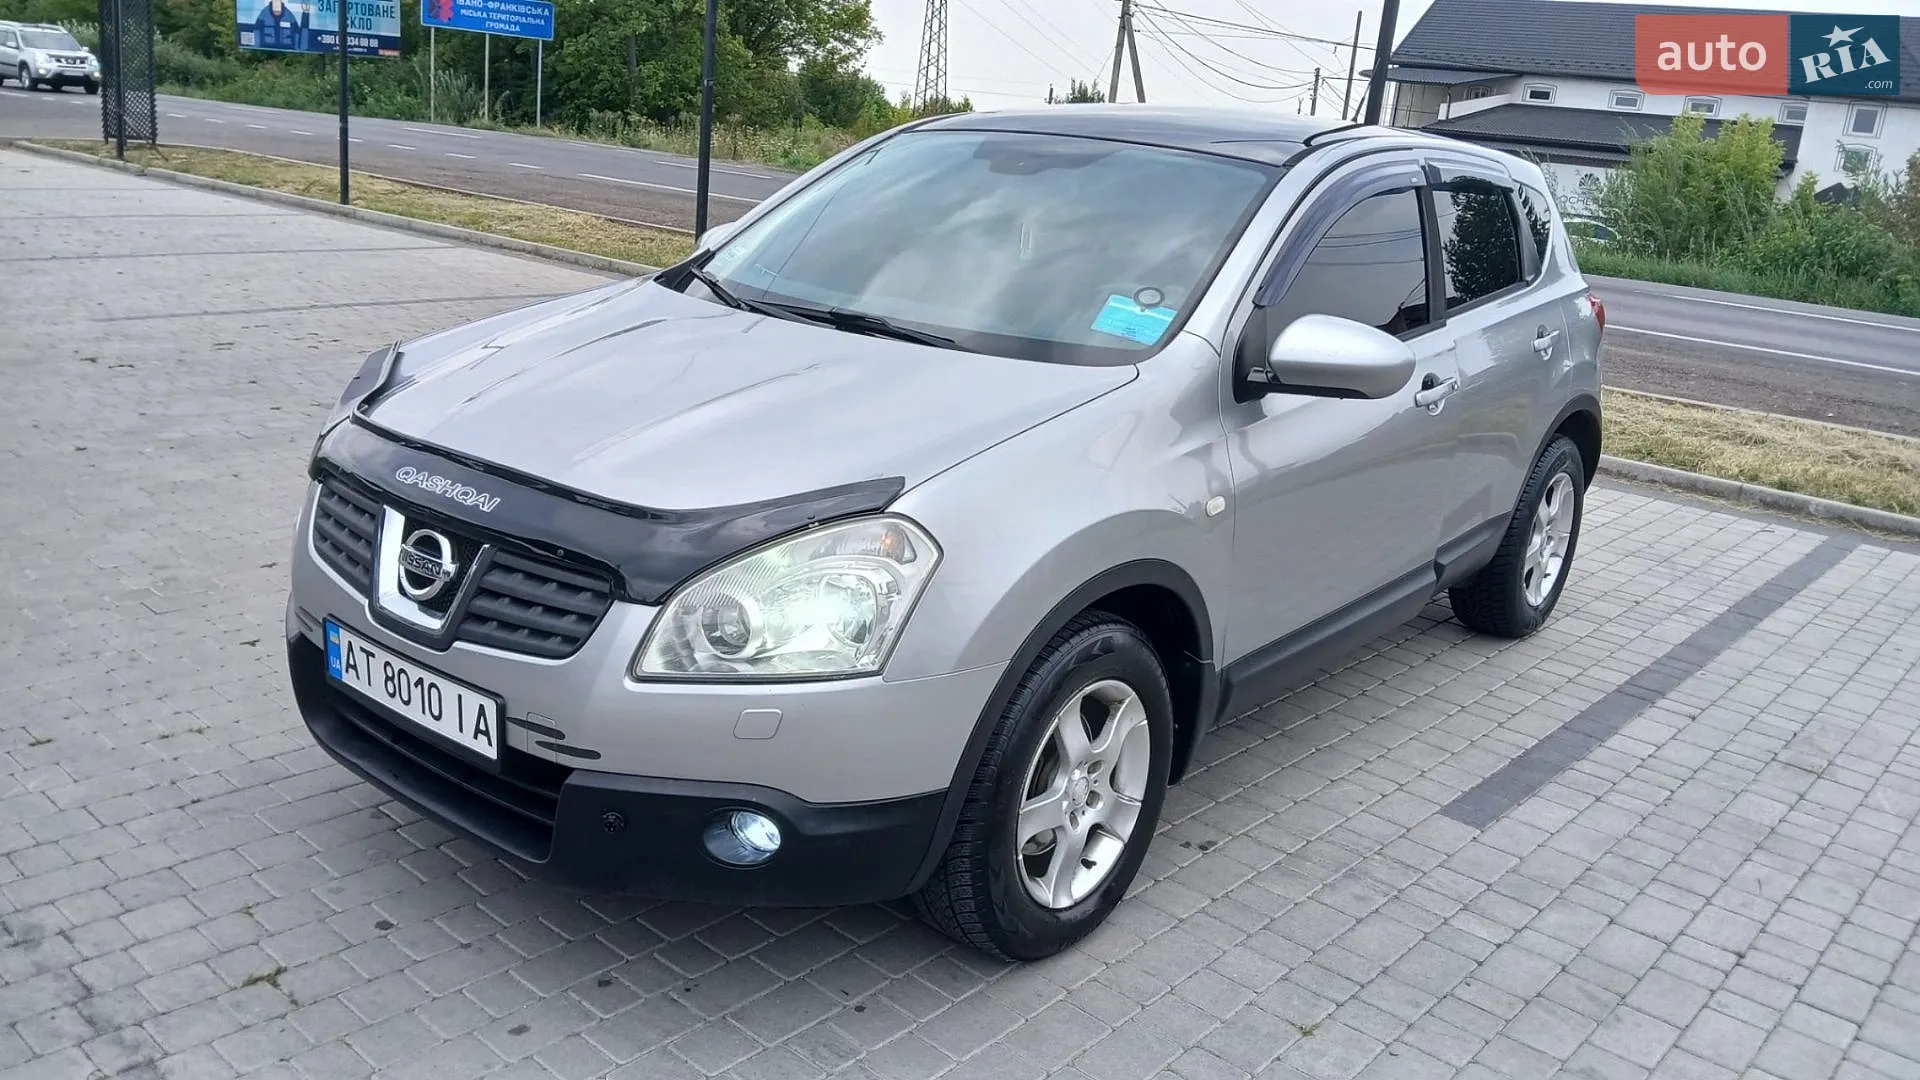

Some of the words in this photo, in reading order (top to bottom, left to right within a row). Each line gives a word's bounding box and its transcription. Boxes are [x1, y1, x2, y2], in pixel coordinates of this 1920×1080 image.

[318, 0, 396, 19] ЗАГРТОВАНЕ
[460, 9, 487, 18] МІСЬКА
[489, 12, 545, 25] ТЕРИТОРІАЛЬНА
[486, 21, 520, 31] ГРОМАДА
[395, 466, 501, 512] QASHQAI
[401, 548, 441, 576] NISSAN
[330, 655, 341, 671] UA
[345, 640, 376, 687] AT
[383, 660, 443, 721] 8010
